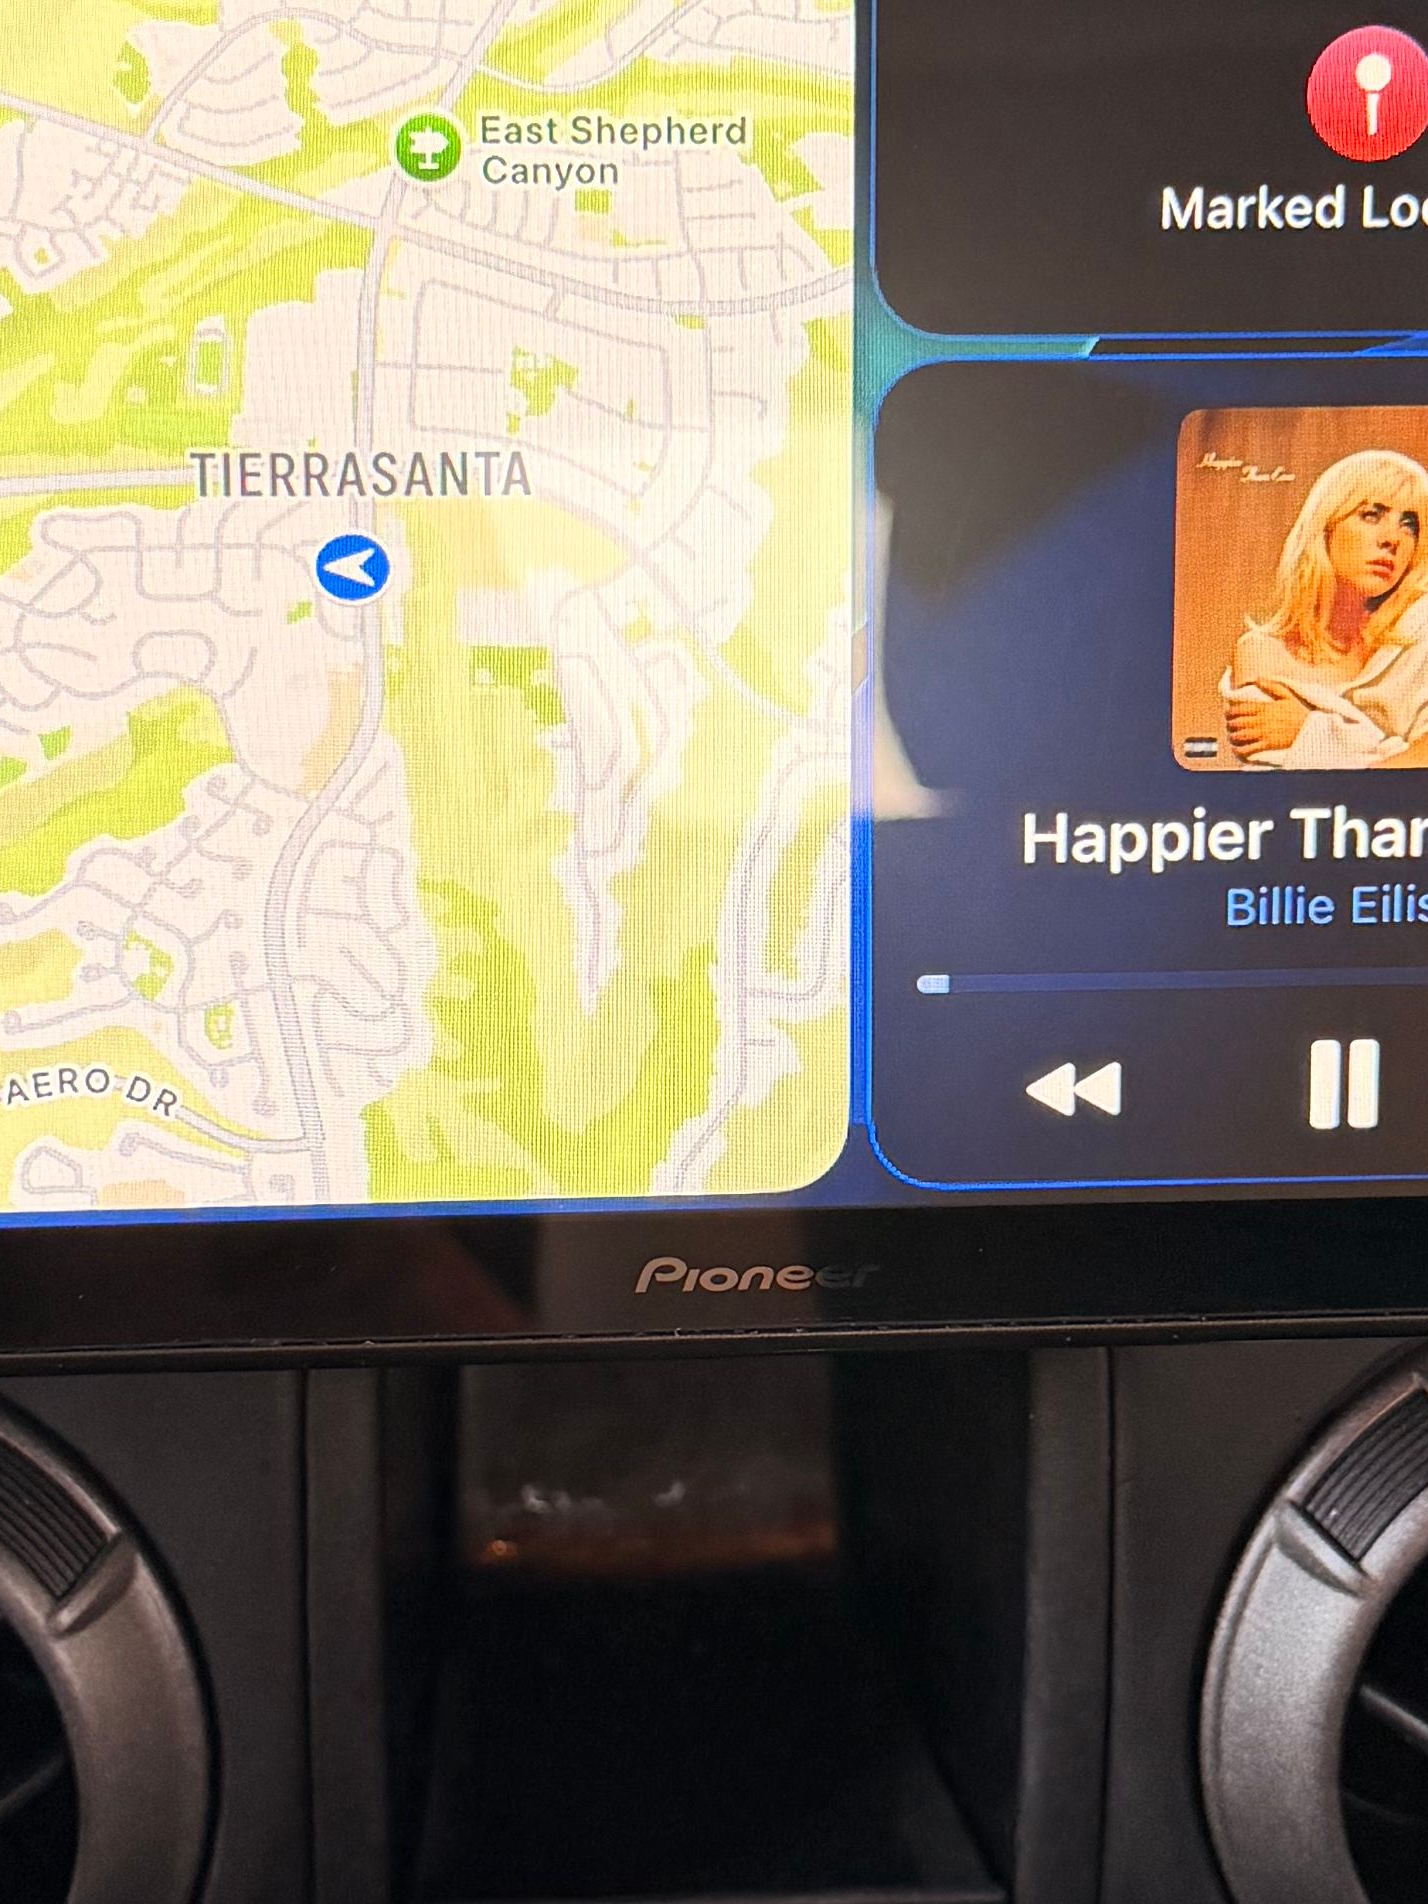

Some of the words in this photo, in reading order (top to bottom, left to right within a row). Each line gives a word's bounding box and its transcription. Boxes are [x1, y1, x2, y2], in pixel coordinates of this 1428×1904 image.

[481, 115, 558, 145] East
[571, 115, 747, 151] Shepherd
[482, 154, 619, 192] Canyon
[1160, 182, 1346, 230] Marked
[189, 450, 532, 498] TIERRASANTA
[1023, 806, 1275, 875] Happier
[1227, 885, 1335, 926] Billie
[7, 1067, 111, 1106] AERO
[126, 1075, 178, 1117] DR
[634, 1256, 881, 1294] Pioneer
